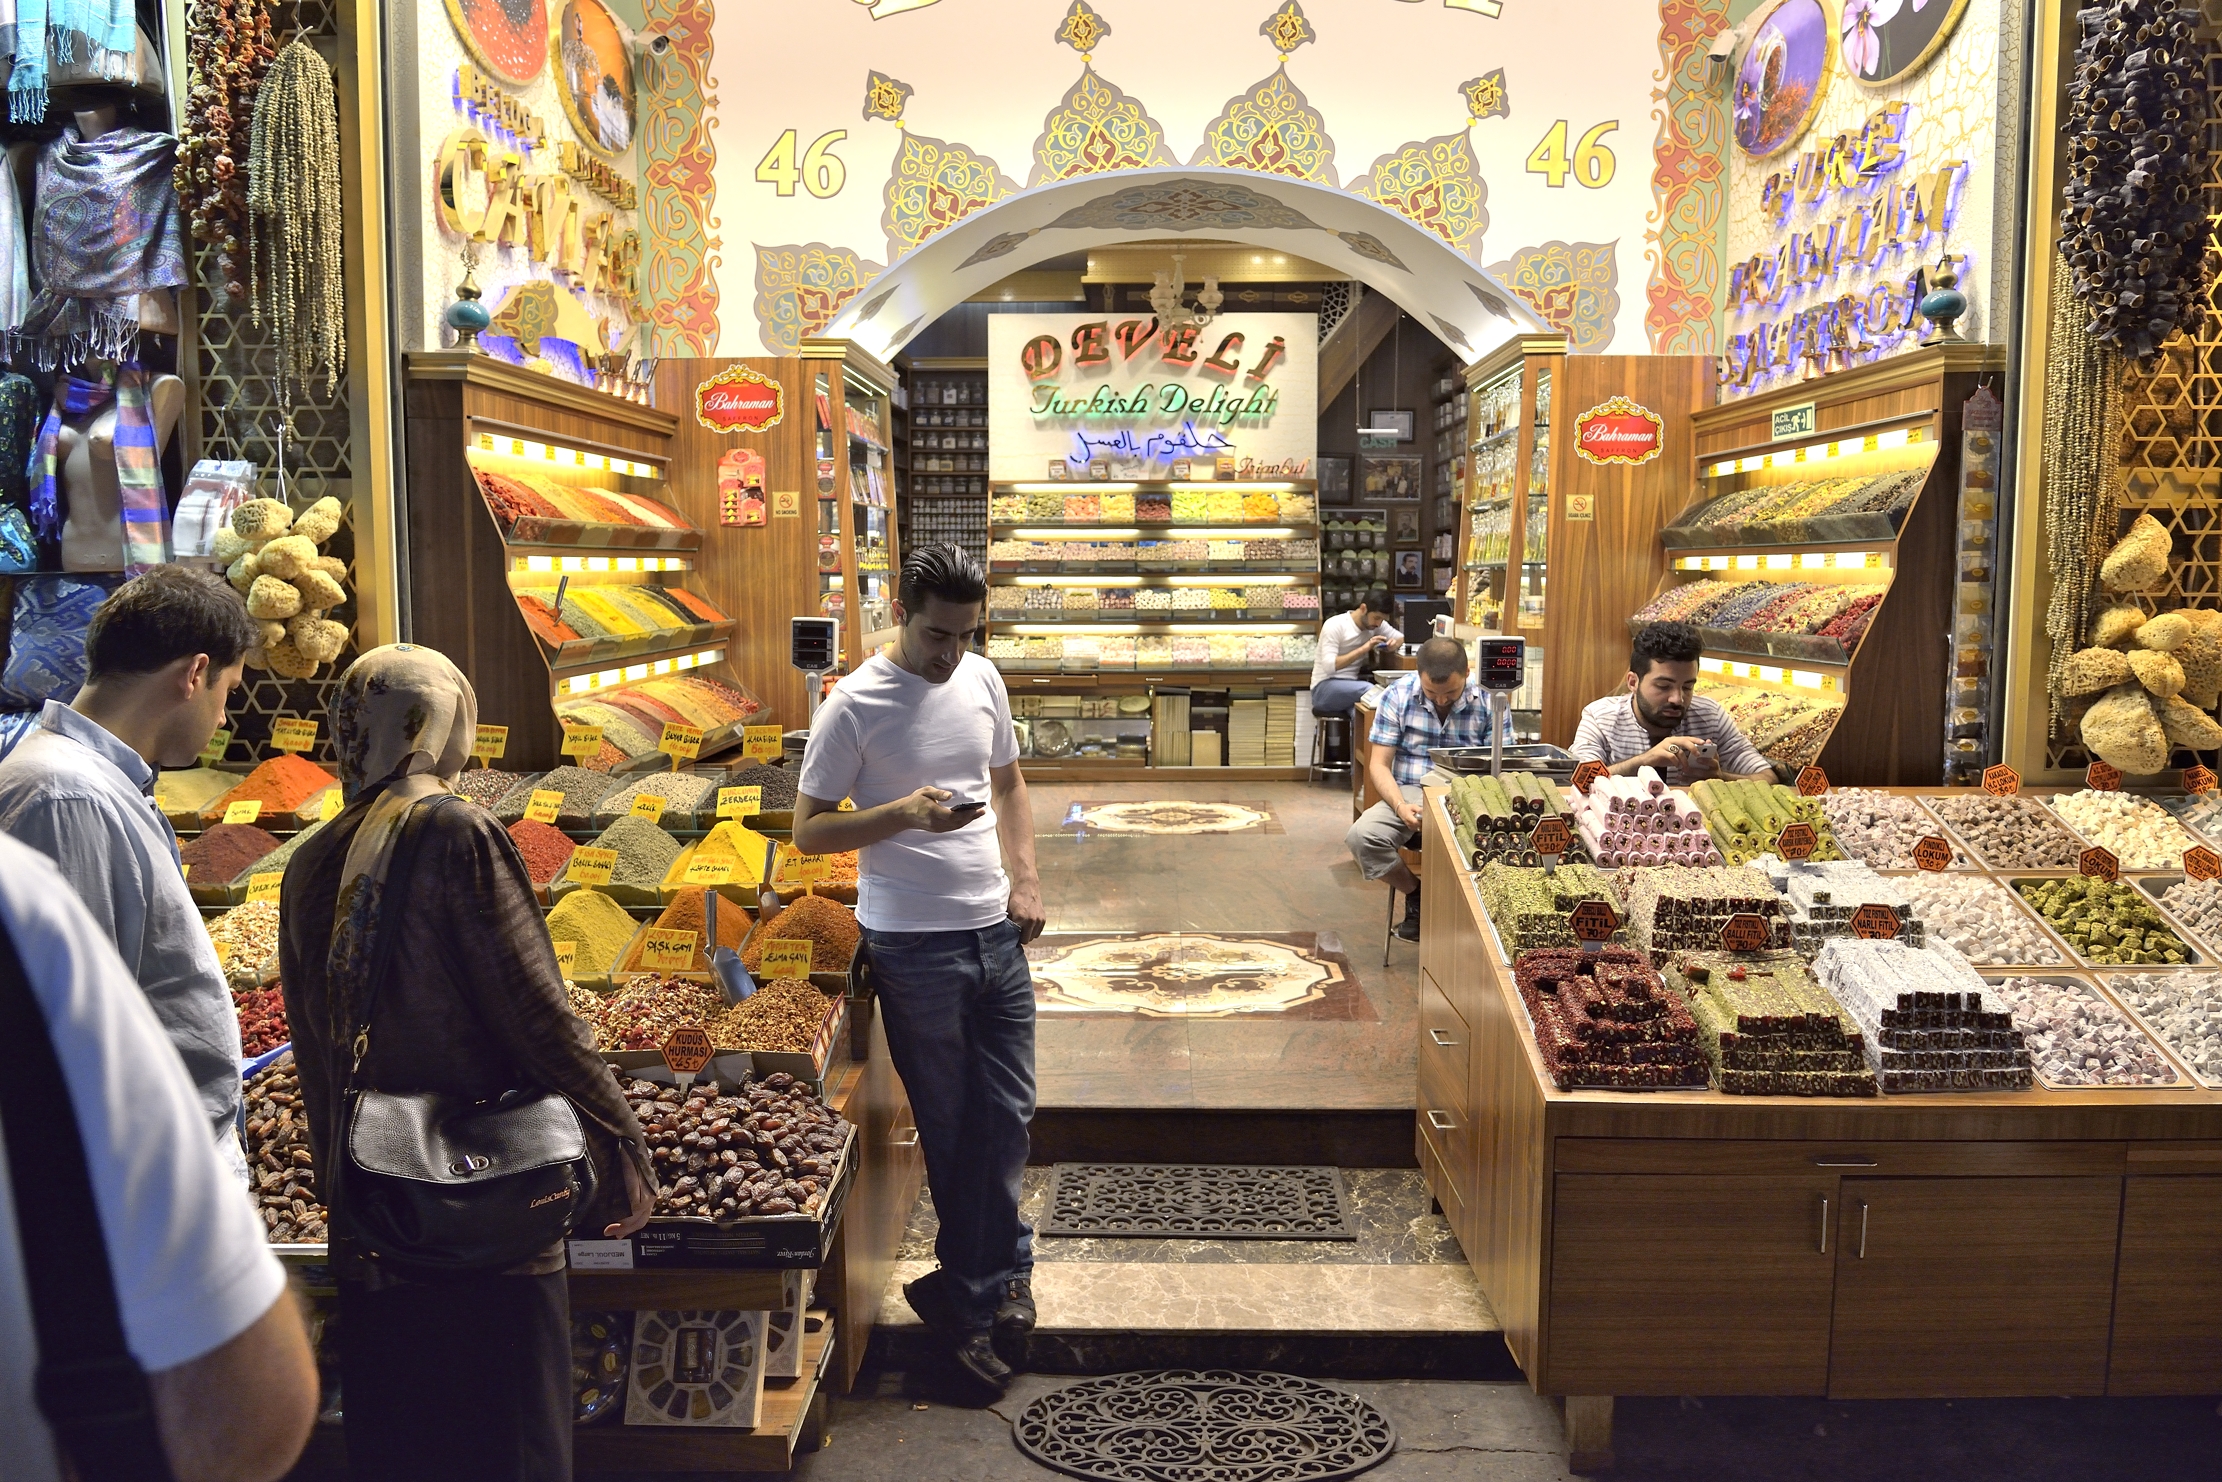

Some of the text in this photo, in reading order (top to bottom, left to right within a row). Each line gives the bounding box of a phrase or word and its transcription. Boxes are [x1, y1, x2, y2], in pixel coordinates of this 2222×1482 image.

[1526, 119, 1619, 188] 46
[756, 129, 847, 198] 46
[704, 391, 775, 412] Bahraman
[1030, 383, 1280, 425] Turkish Delight
[1583, 423, 1655, 443] Bahraman
[1359, 437, 1398, 449] CASH
[1997, 774, 2016, 786] LOKUM
[2187, 776, 2215, 790] LOKUM
[1536, 832, 1567, 843] FİTİL
[1923, 840, 1946, 852] FINDIKLI
[577, 848, 614, 859] FISH SPICE
[1917, 848, 1949, 862] LOKUM
[785, 858, 797, 868] ET
[2083, 854, 2115, 880] LOKUM
[1863, 909, 1872, 919] TOZ
[1576, 917, 1613, 928] FİTİL
[1857, 919, 1895, 931] NARLI FİTİL
[677, 931, 695, 940] TEA
[1727, 929, 1746, 939] BALLI
[765, 941, 809, 952] APPLE TEA
[765, 952, 788, 963] ELMA
[676, 1032, 703, 1045] KUDÜS
[668, 1045, 708, 1058] HURMASI
[776, 1247, 817, 1260] Jordan River
